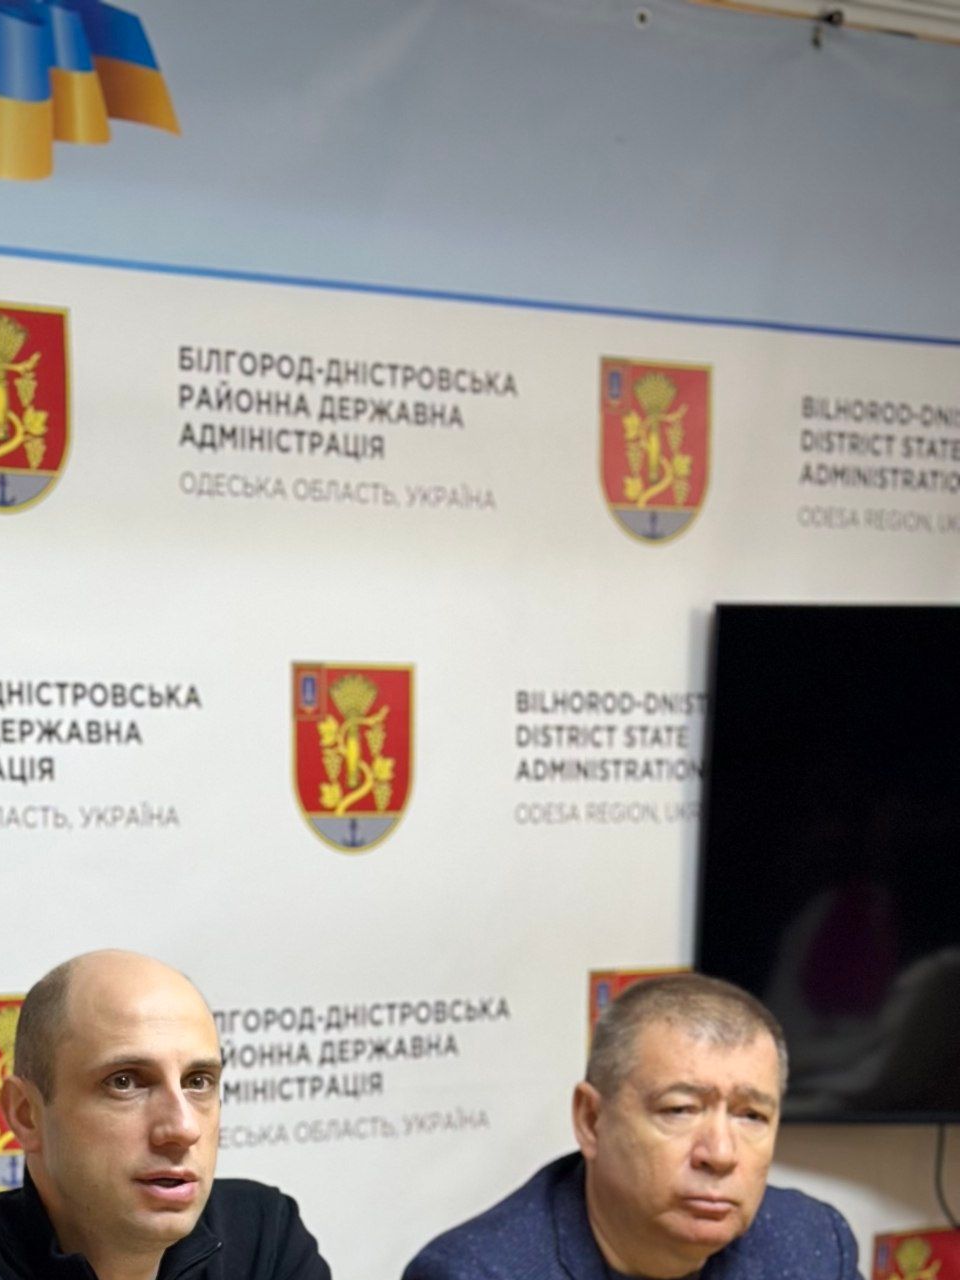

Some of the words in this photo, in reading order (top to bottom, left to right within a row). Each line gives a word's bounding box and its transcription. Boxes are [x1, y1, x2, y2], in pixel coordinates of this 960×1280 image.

[178, 346, 518, 396] БІЛГОРОД-ДНІСТРОВСЬКА
[178, 381, 311, 417] РАЙОННА
[317, 395, 464, 428] ДЕРЖАВНА
[179, 422, 385, 460] АДМІНІСТРАЦІЯ
[801, 430, 894, 457] DISTRICT
[179, 471, 287, 499] ОДЕСЬКА
[292, 478, 400, 508] ОБЛАСТЬ,
[405, 483, 497, 510] УКРАЇНА
[516, 725, 617, 748] DISTRICT
[624, 725, 689, 748] STATE
[79, 802, 181, 830] УКРАЇНА
[515, 802, 580, 825] ODESA
[320, 1034, 459, 1066] ДЕРЖАВНА
[221, 1071, 384, 1106] МІНІСТРАЦІЯ
[402, 1106, 490, 1136] УКРАЇНА
